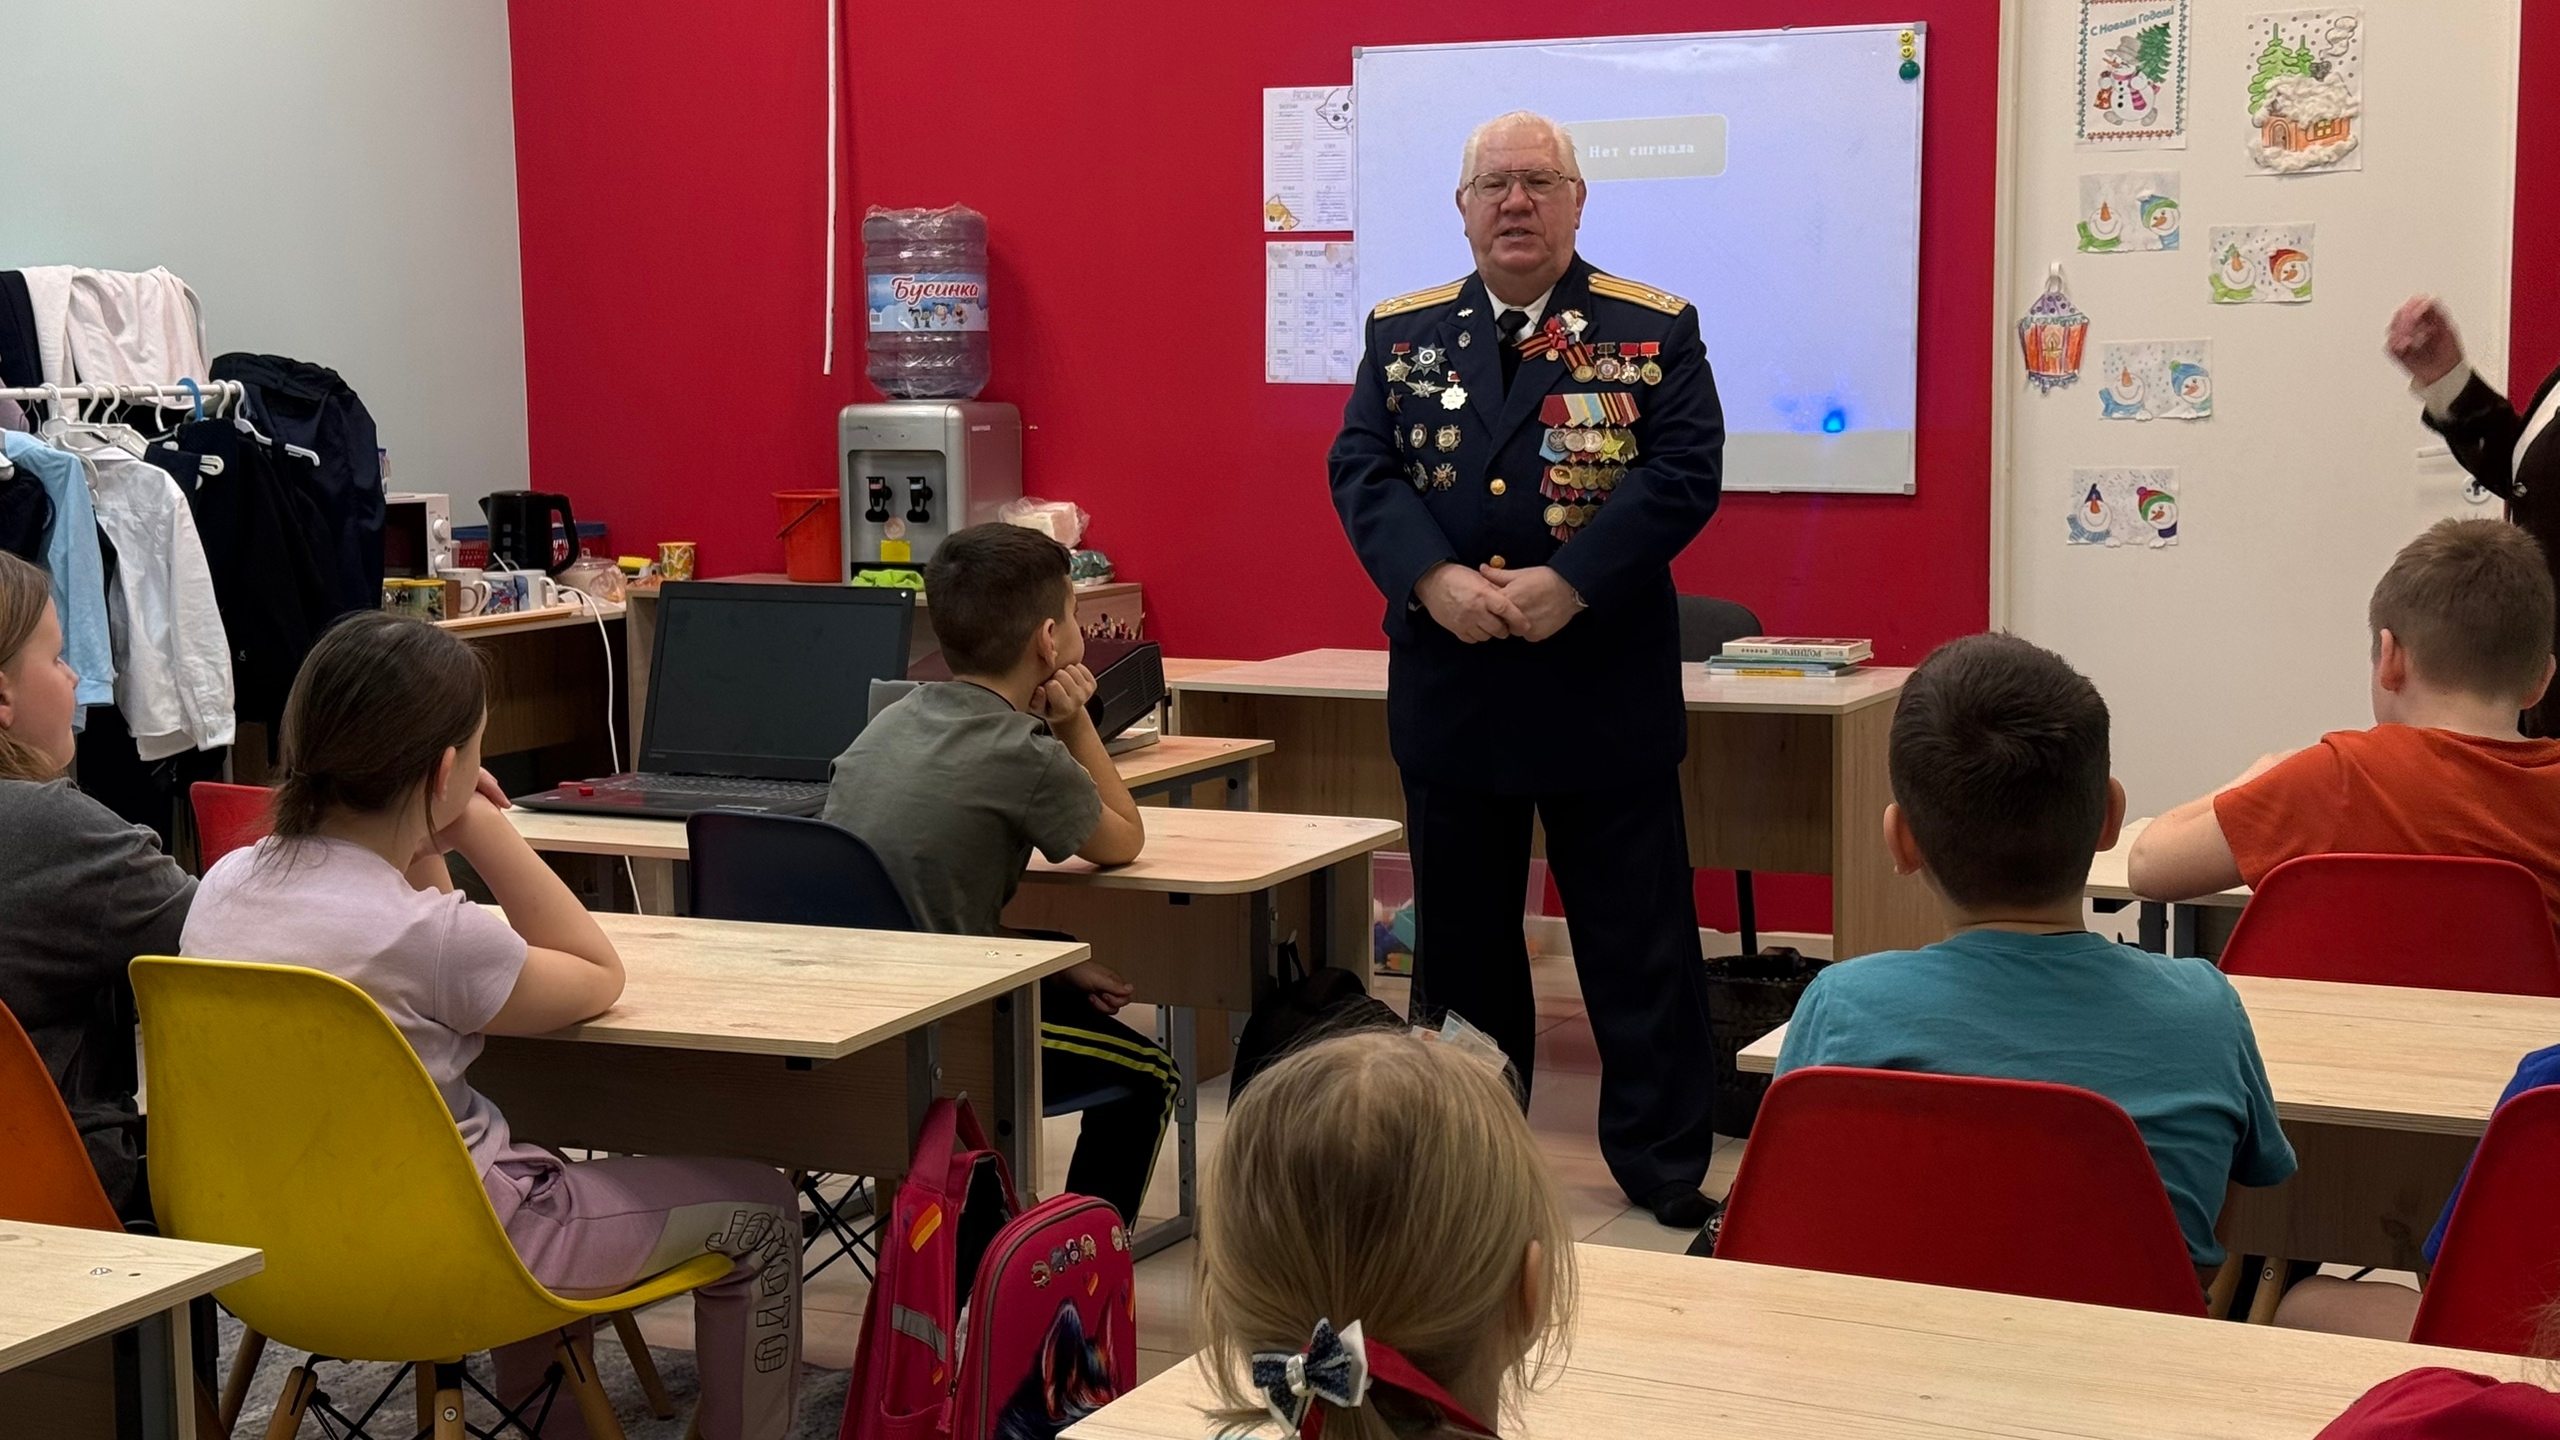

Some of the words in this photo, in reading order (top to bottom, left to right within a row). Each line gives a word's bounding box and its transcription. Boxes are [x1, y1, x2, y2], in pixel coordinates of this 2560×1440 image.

[2090, 26, 2098, 36] С
[2099, 17, 2137, 35] Новым
[2138, 5, 2175, 24] Годом!
[1588, 145, 1620, 158] Нет
[1629, 144, 1695, 156] сигнала
[891, 275, 979, 306] Бусинка
[1771, 648, 1822, 658] РОДНИЧОК
